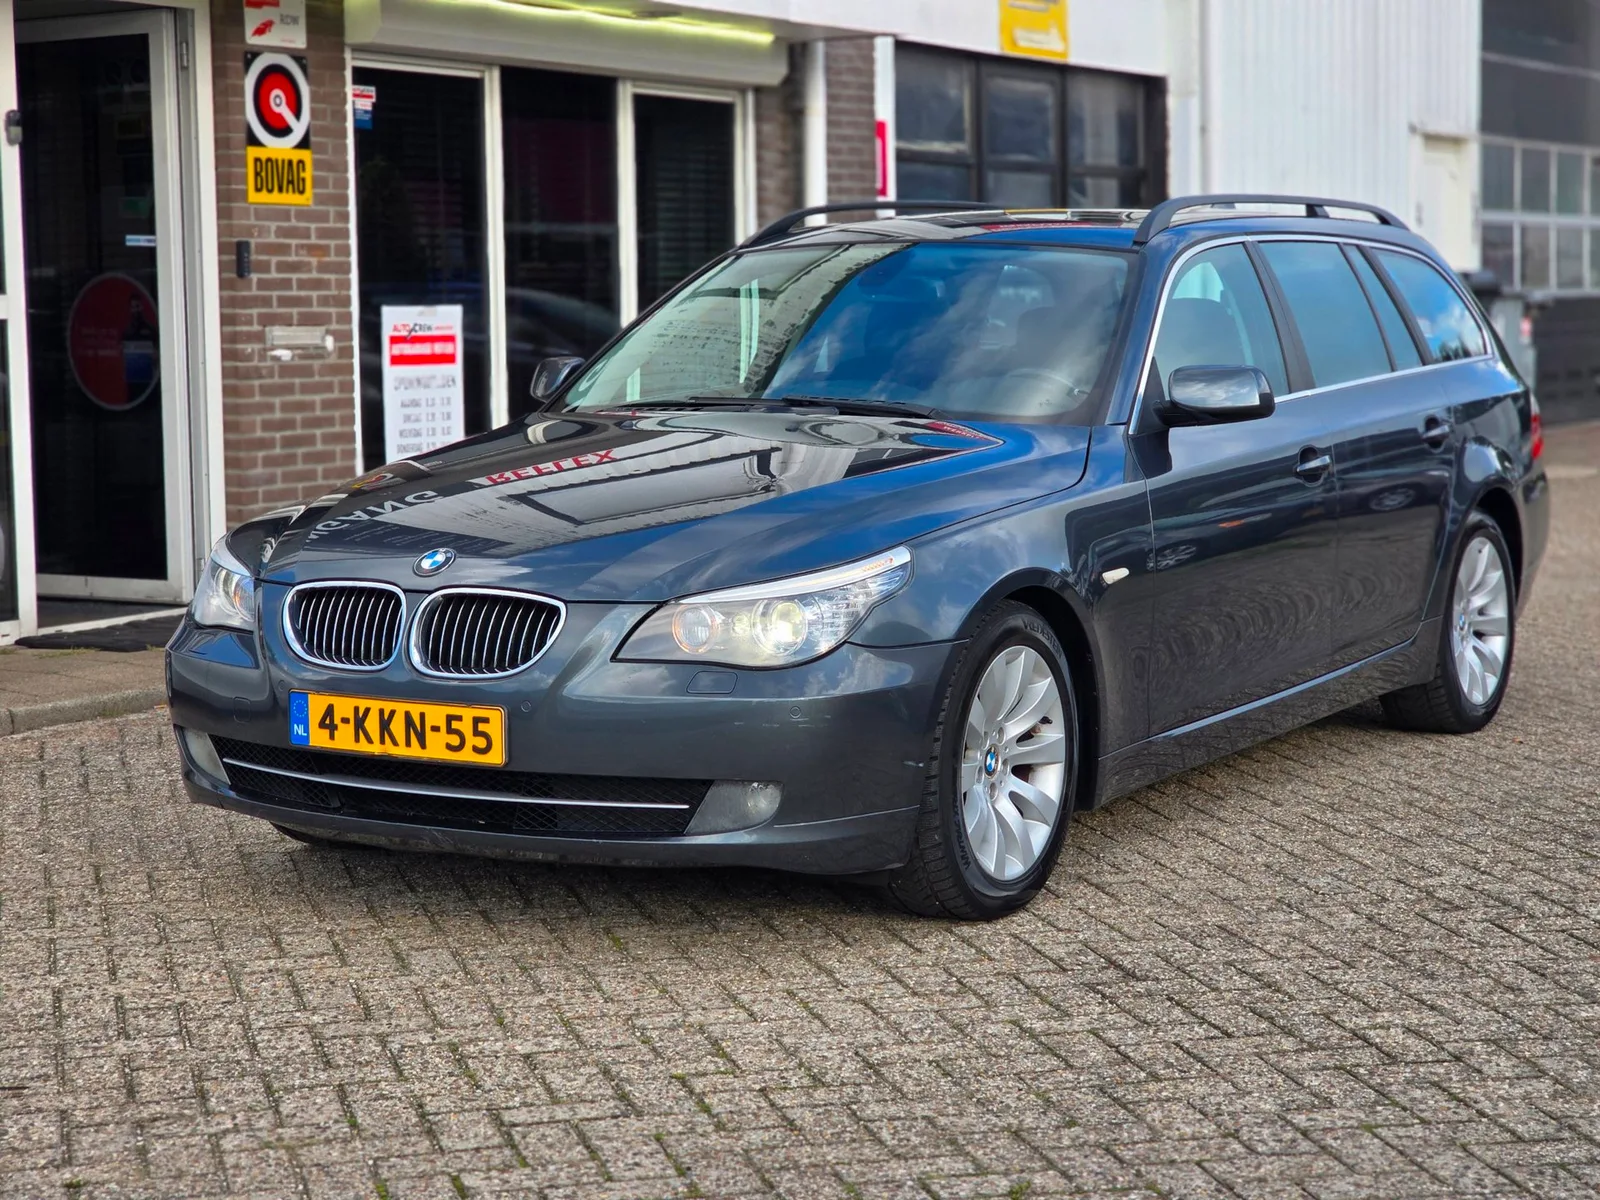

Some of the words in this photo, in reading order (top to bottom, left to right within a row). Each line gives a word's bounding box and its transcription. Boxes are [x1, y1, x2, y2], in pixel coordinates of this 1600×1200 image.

[253, 156, 306, 195] BOVAG
[293, 723, 308, 736] NL
[317, 703, 494, 756] 4-KKN-55
